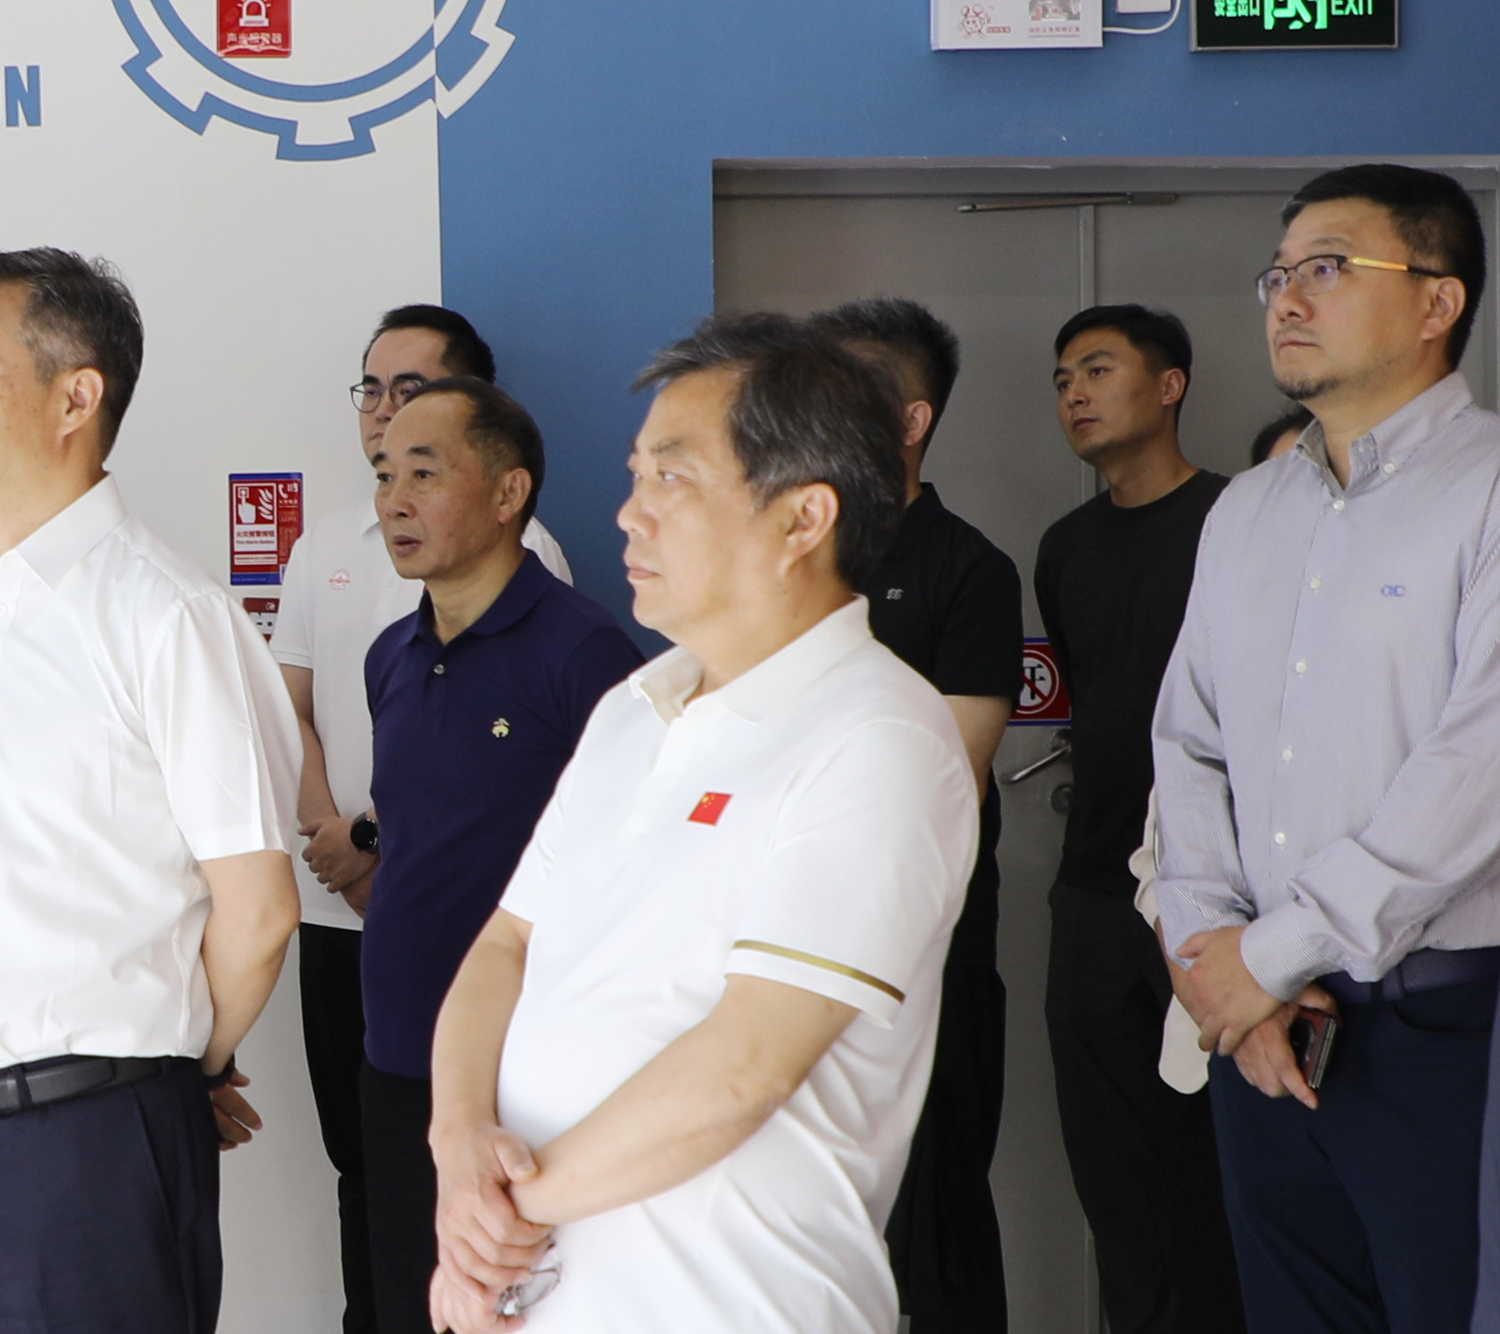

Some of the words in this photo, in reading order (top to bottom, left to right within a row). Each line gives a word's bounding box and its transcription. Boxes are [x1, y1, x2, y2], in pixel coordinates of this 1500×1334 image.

[226, 32, 283, 44] 声光报警器
